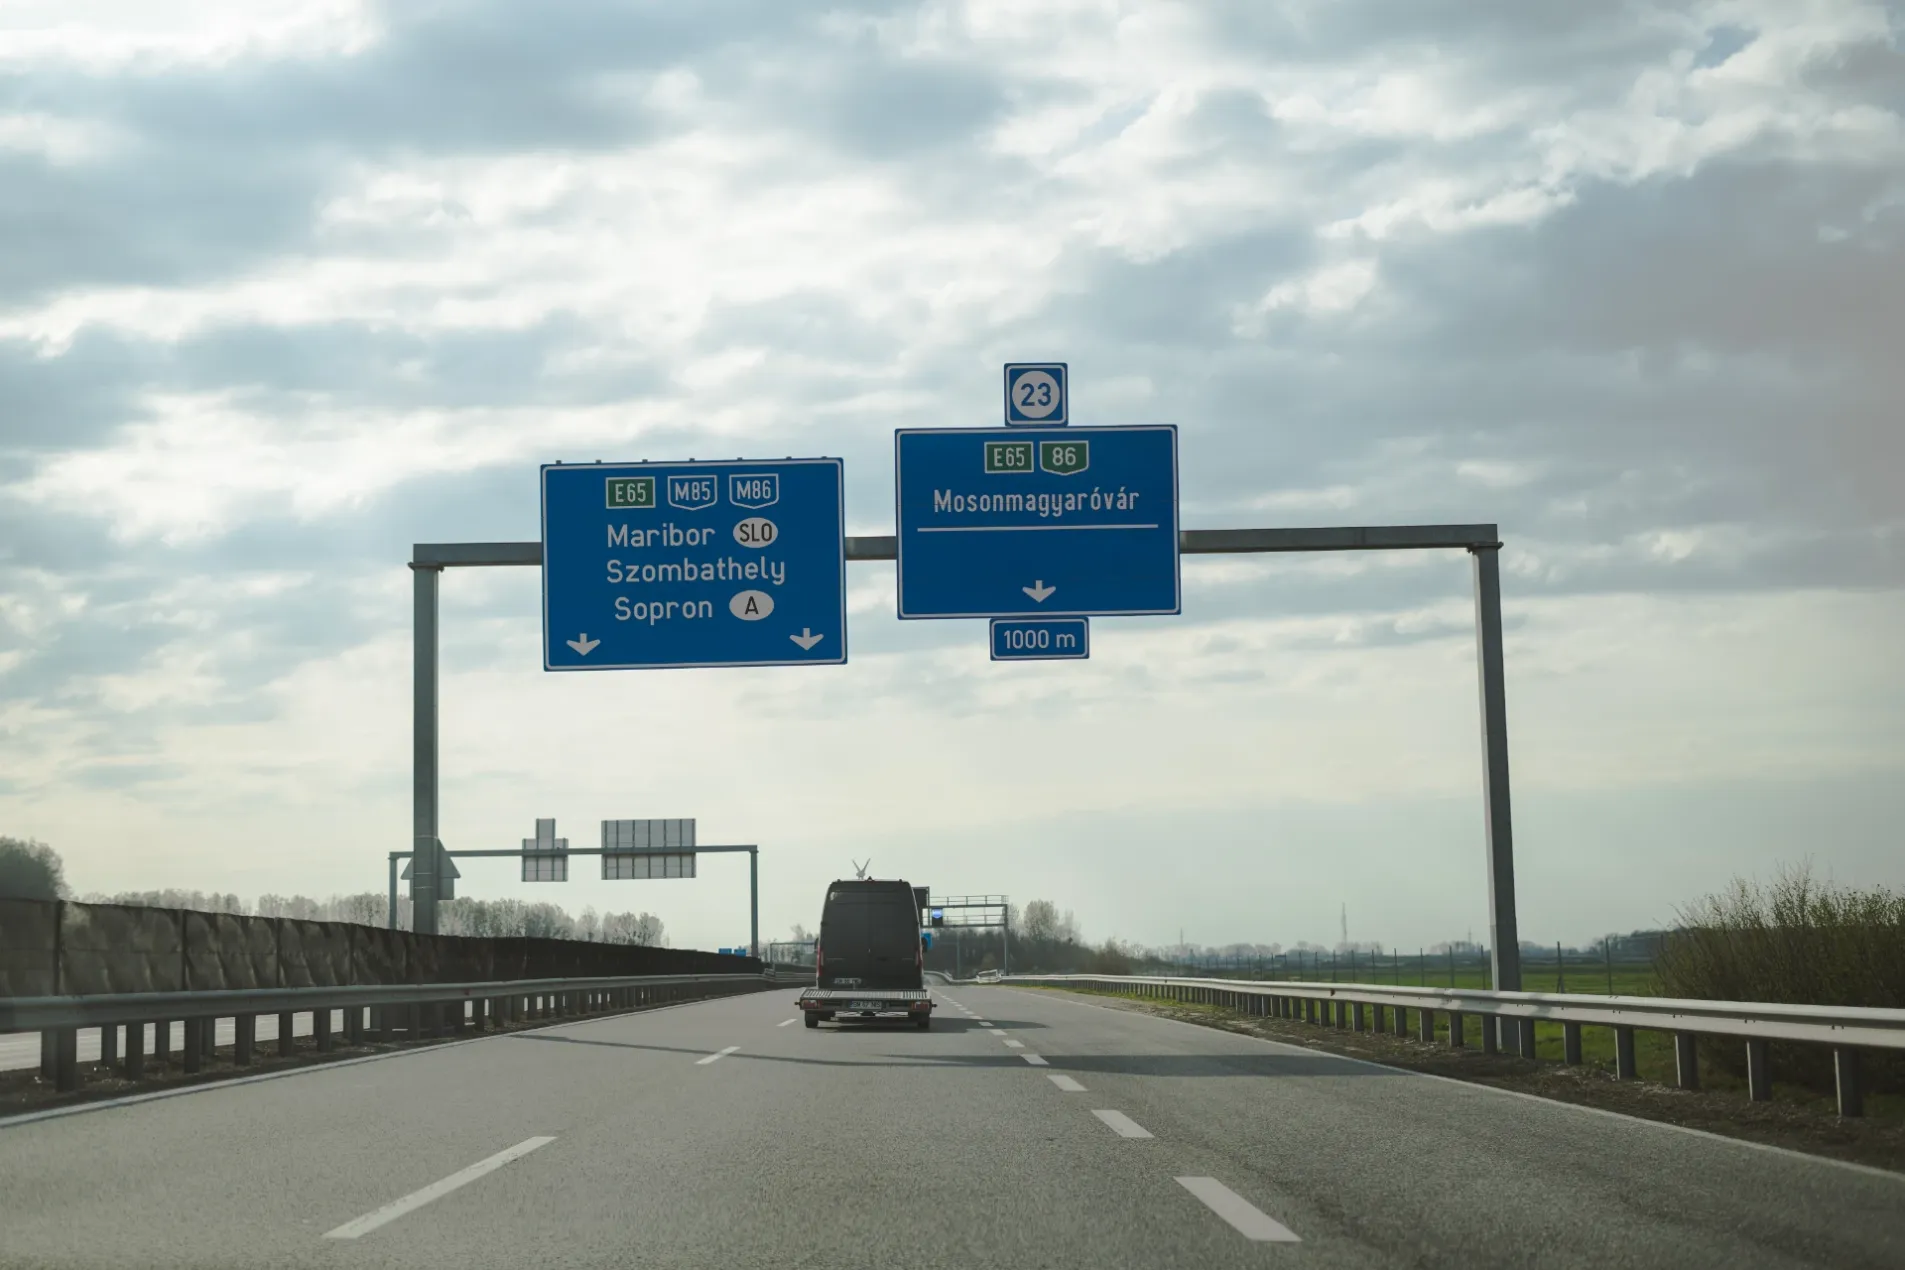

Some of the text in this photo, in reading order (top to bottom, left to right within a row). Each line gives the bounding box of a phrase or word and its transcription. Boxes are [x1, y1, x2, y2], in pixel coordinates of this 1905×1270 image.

[1020, 382, 1052, 407] 23
[993, 446, 1076, 467] E65 86
[615, 479, 771, 503] E65 M85 M86
[933, 486, 1140, 517] Mosonmagyaróvár
[607, 522, 773, 548] Maribor SLO
[606, 556, 786, 586] Szombathely
[614, 595, 759, 626] Sopron A
[1003, 629, 1076, 649] 1000 m
